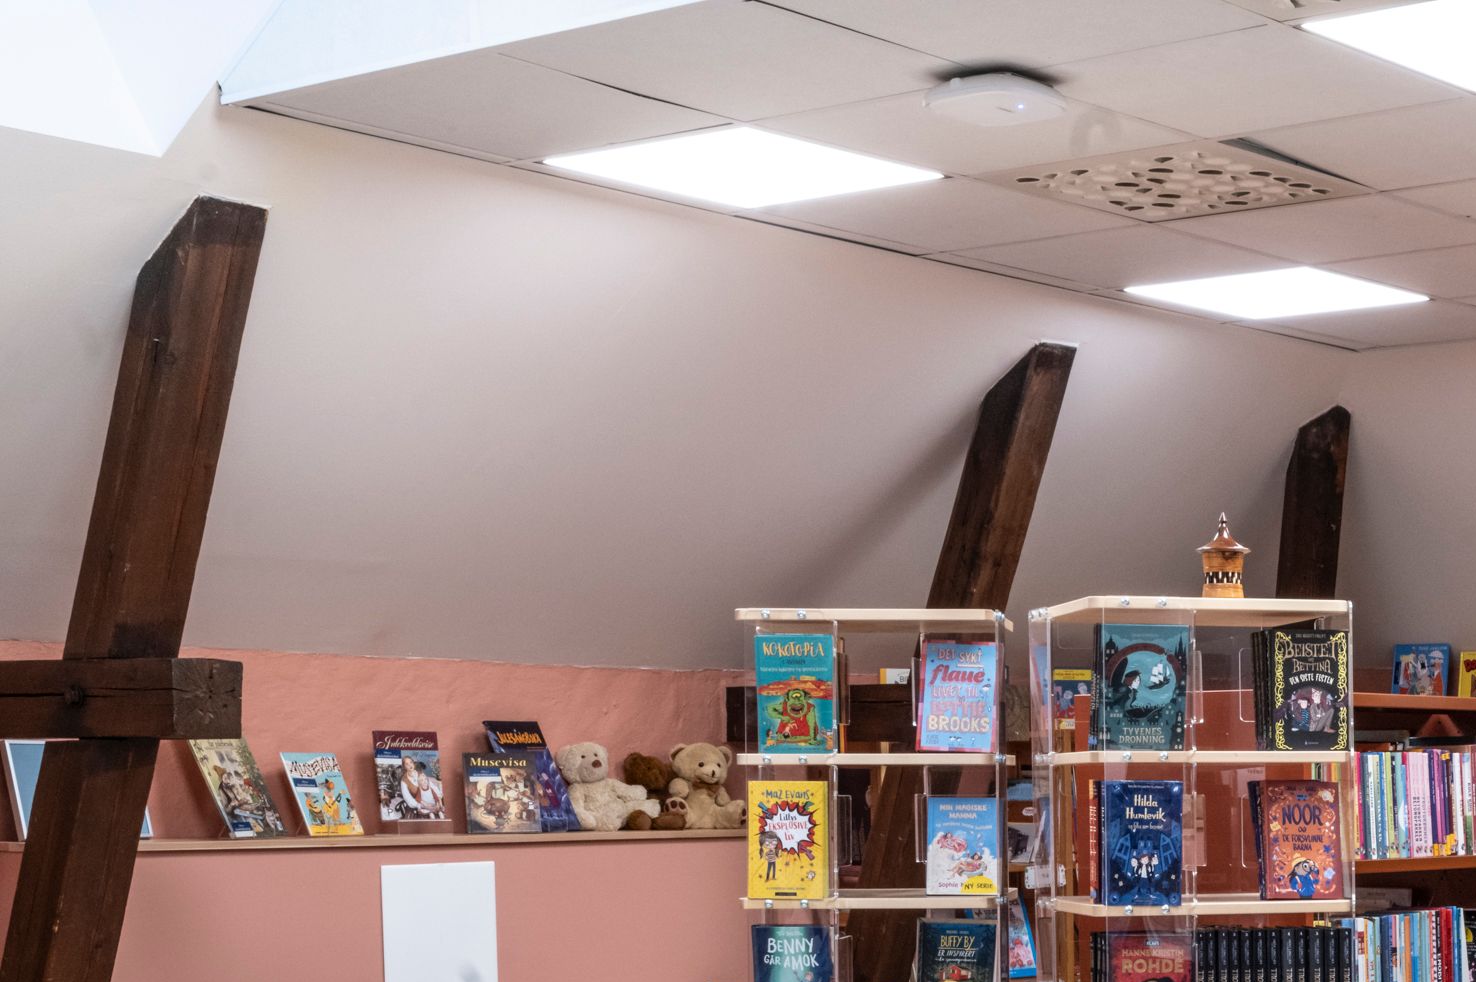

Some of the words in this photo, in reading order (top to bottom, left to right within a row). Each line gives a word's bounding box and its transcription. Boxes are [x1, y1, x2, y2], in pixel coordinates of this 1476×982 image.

[1293, 659, 1333, 674] BETTINA
[929, 664, 985, 685] flaue
[928, 715, 990, 732] BROOKS
[1122, 727, 1162, 735] TYVENES
[1119, 735, 1165, 744] DRONNING
[469, 756, 528, 769] Musevisa
[1134, 794, 1158, 807] Hilda
[1125, 807, 1166, 822] Humlevik
[1282, 803, 1324, 826] NOOR
[767, 937, 814, 955] BENNY
[940, 935, 963, 948] BUFFY
[963, 935, 975, 950] BY
[783, 953, 820, 971] AMOK
[1121, 959, 1185, 974] ROHDE
